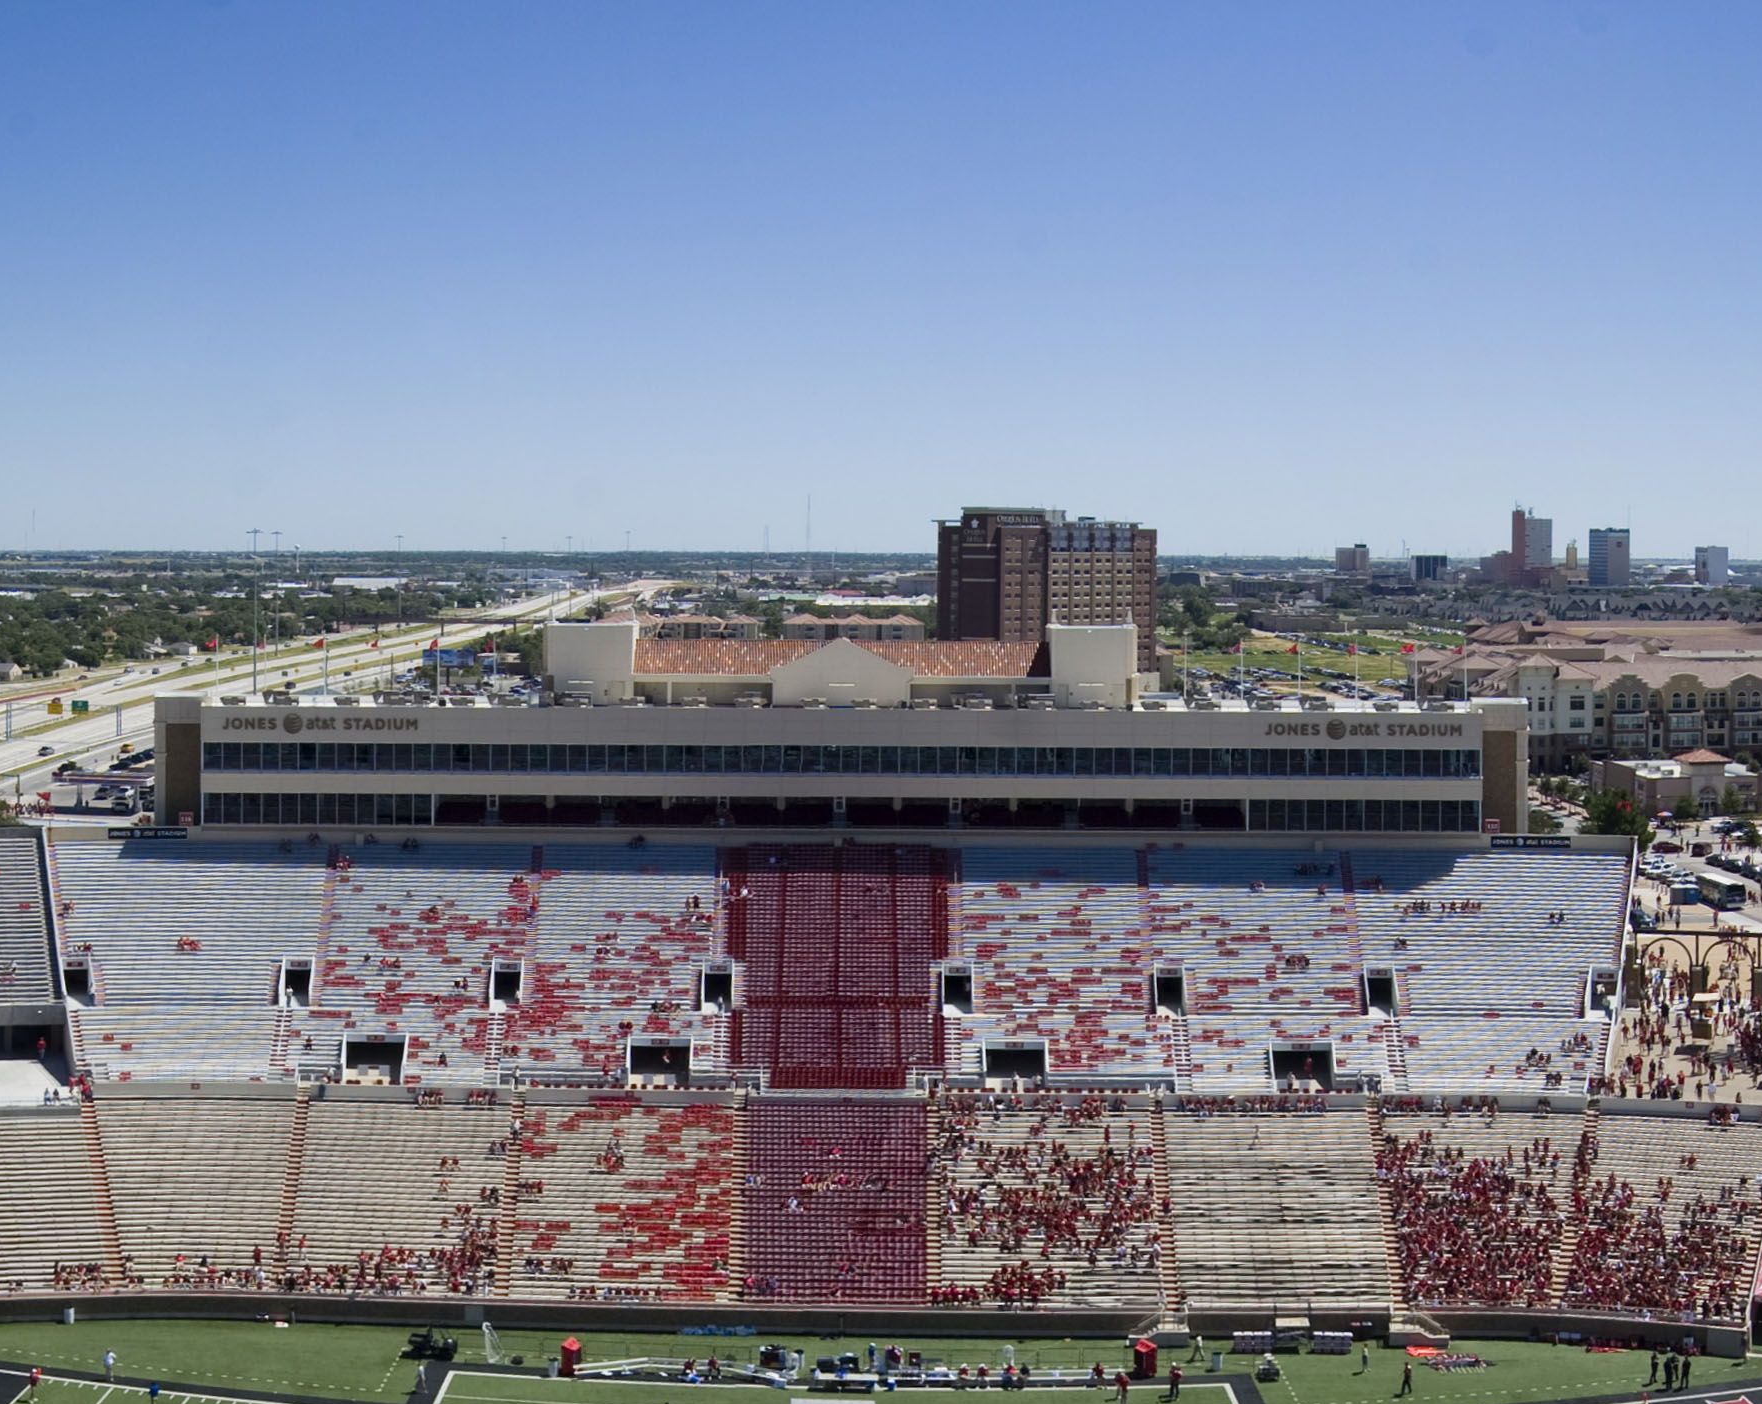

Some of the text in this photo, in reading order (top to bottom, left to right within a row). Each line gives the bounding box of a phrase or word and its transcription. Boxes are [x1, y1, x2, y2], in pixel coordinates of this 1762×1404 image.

[222, 717, 418, 731] JONES at&t STADIUM
[1265, 723, 1462, 736] JONES at&t STADIUM
